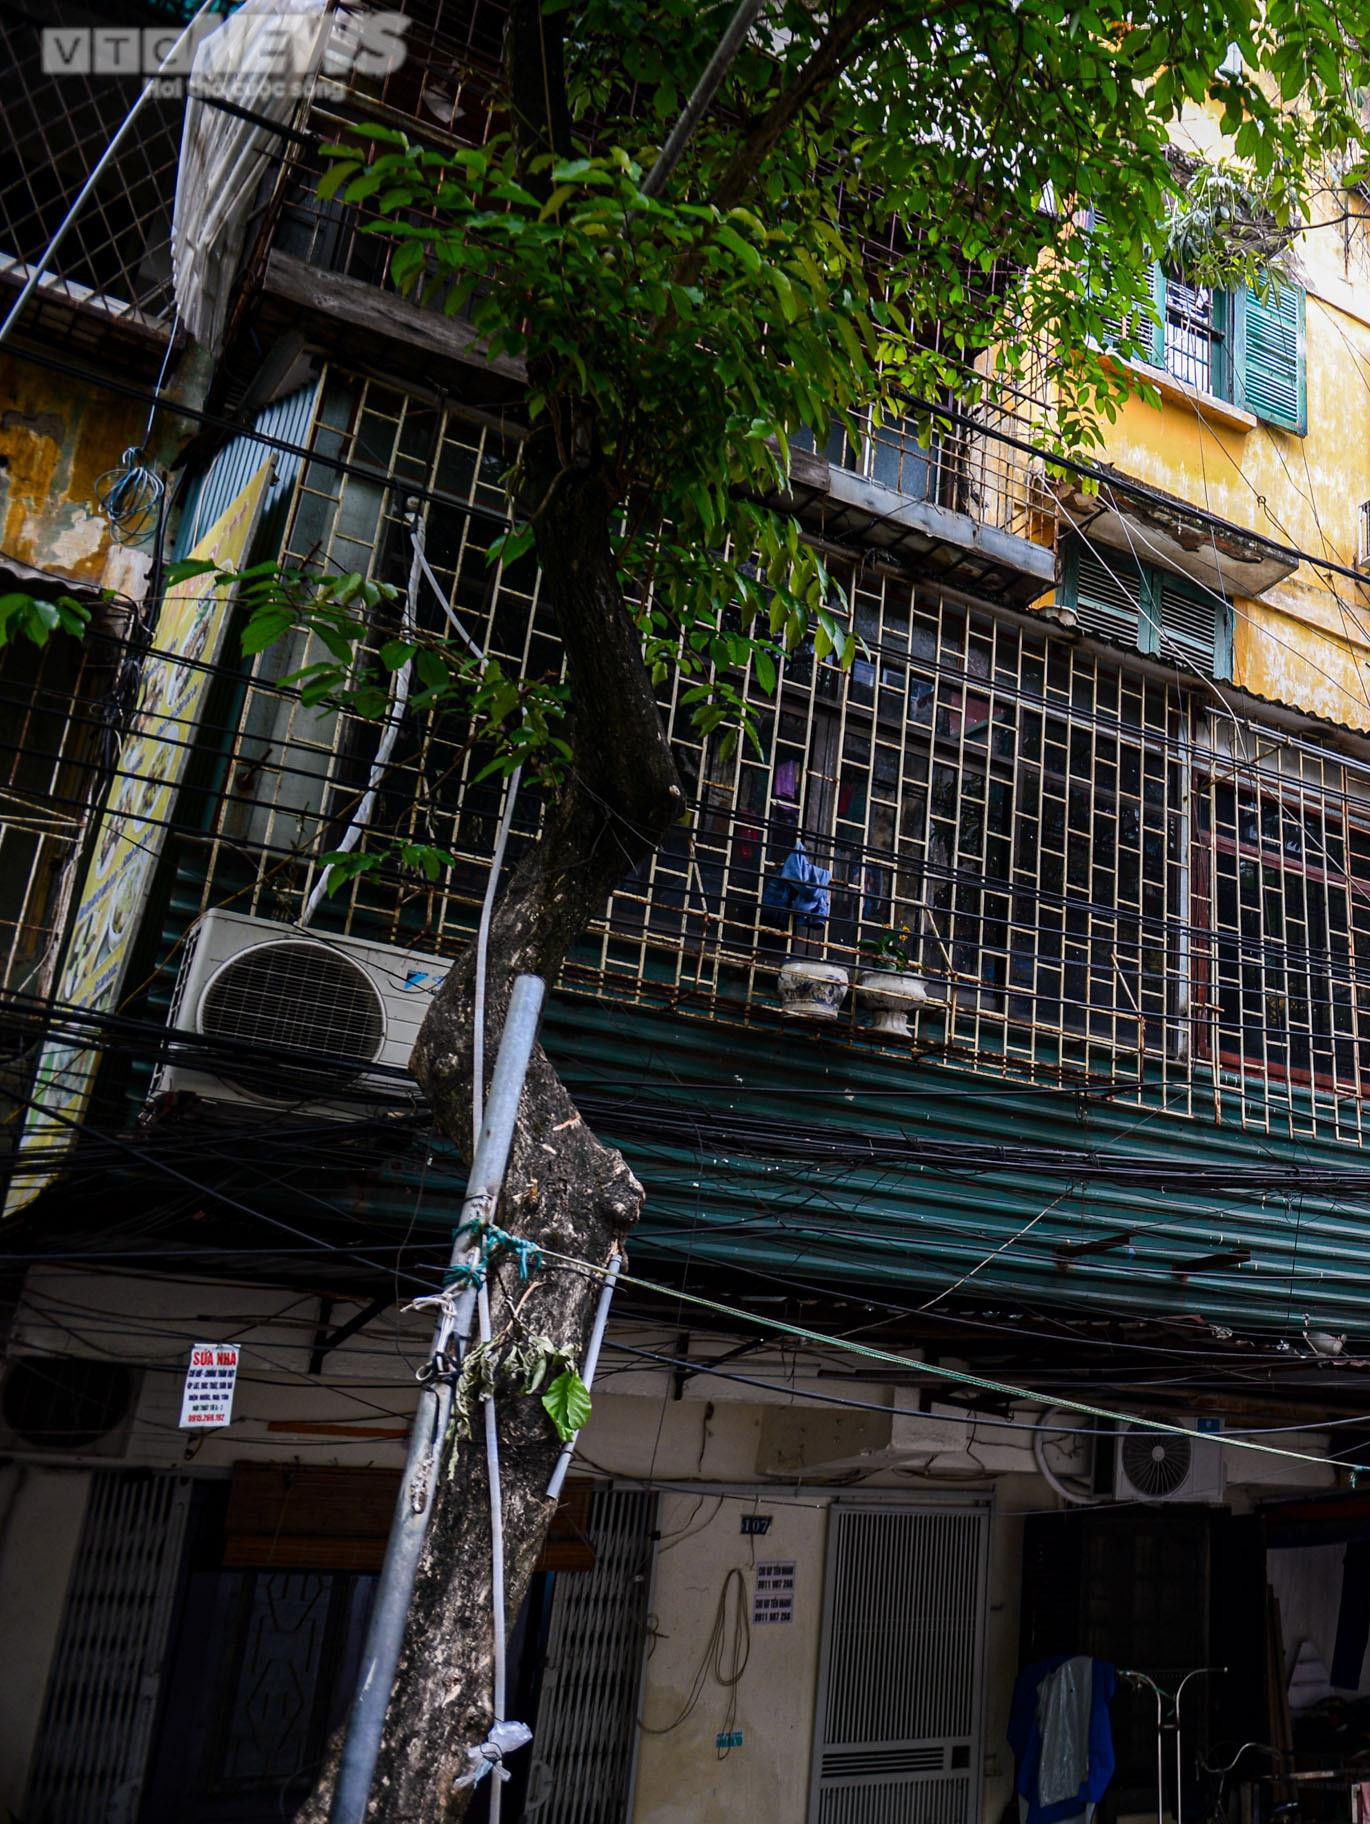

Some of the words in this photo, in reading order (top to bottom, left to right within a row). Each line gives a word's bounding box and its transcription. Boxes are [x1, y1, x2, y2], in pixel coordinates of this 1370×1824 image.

[193, 1349, 213, 1365] SỬA
[217, 1350, 236, 1365] NHÀ
[745, 1519, 769, 1533] 107
